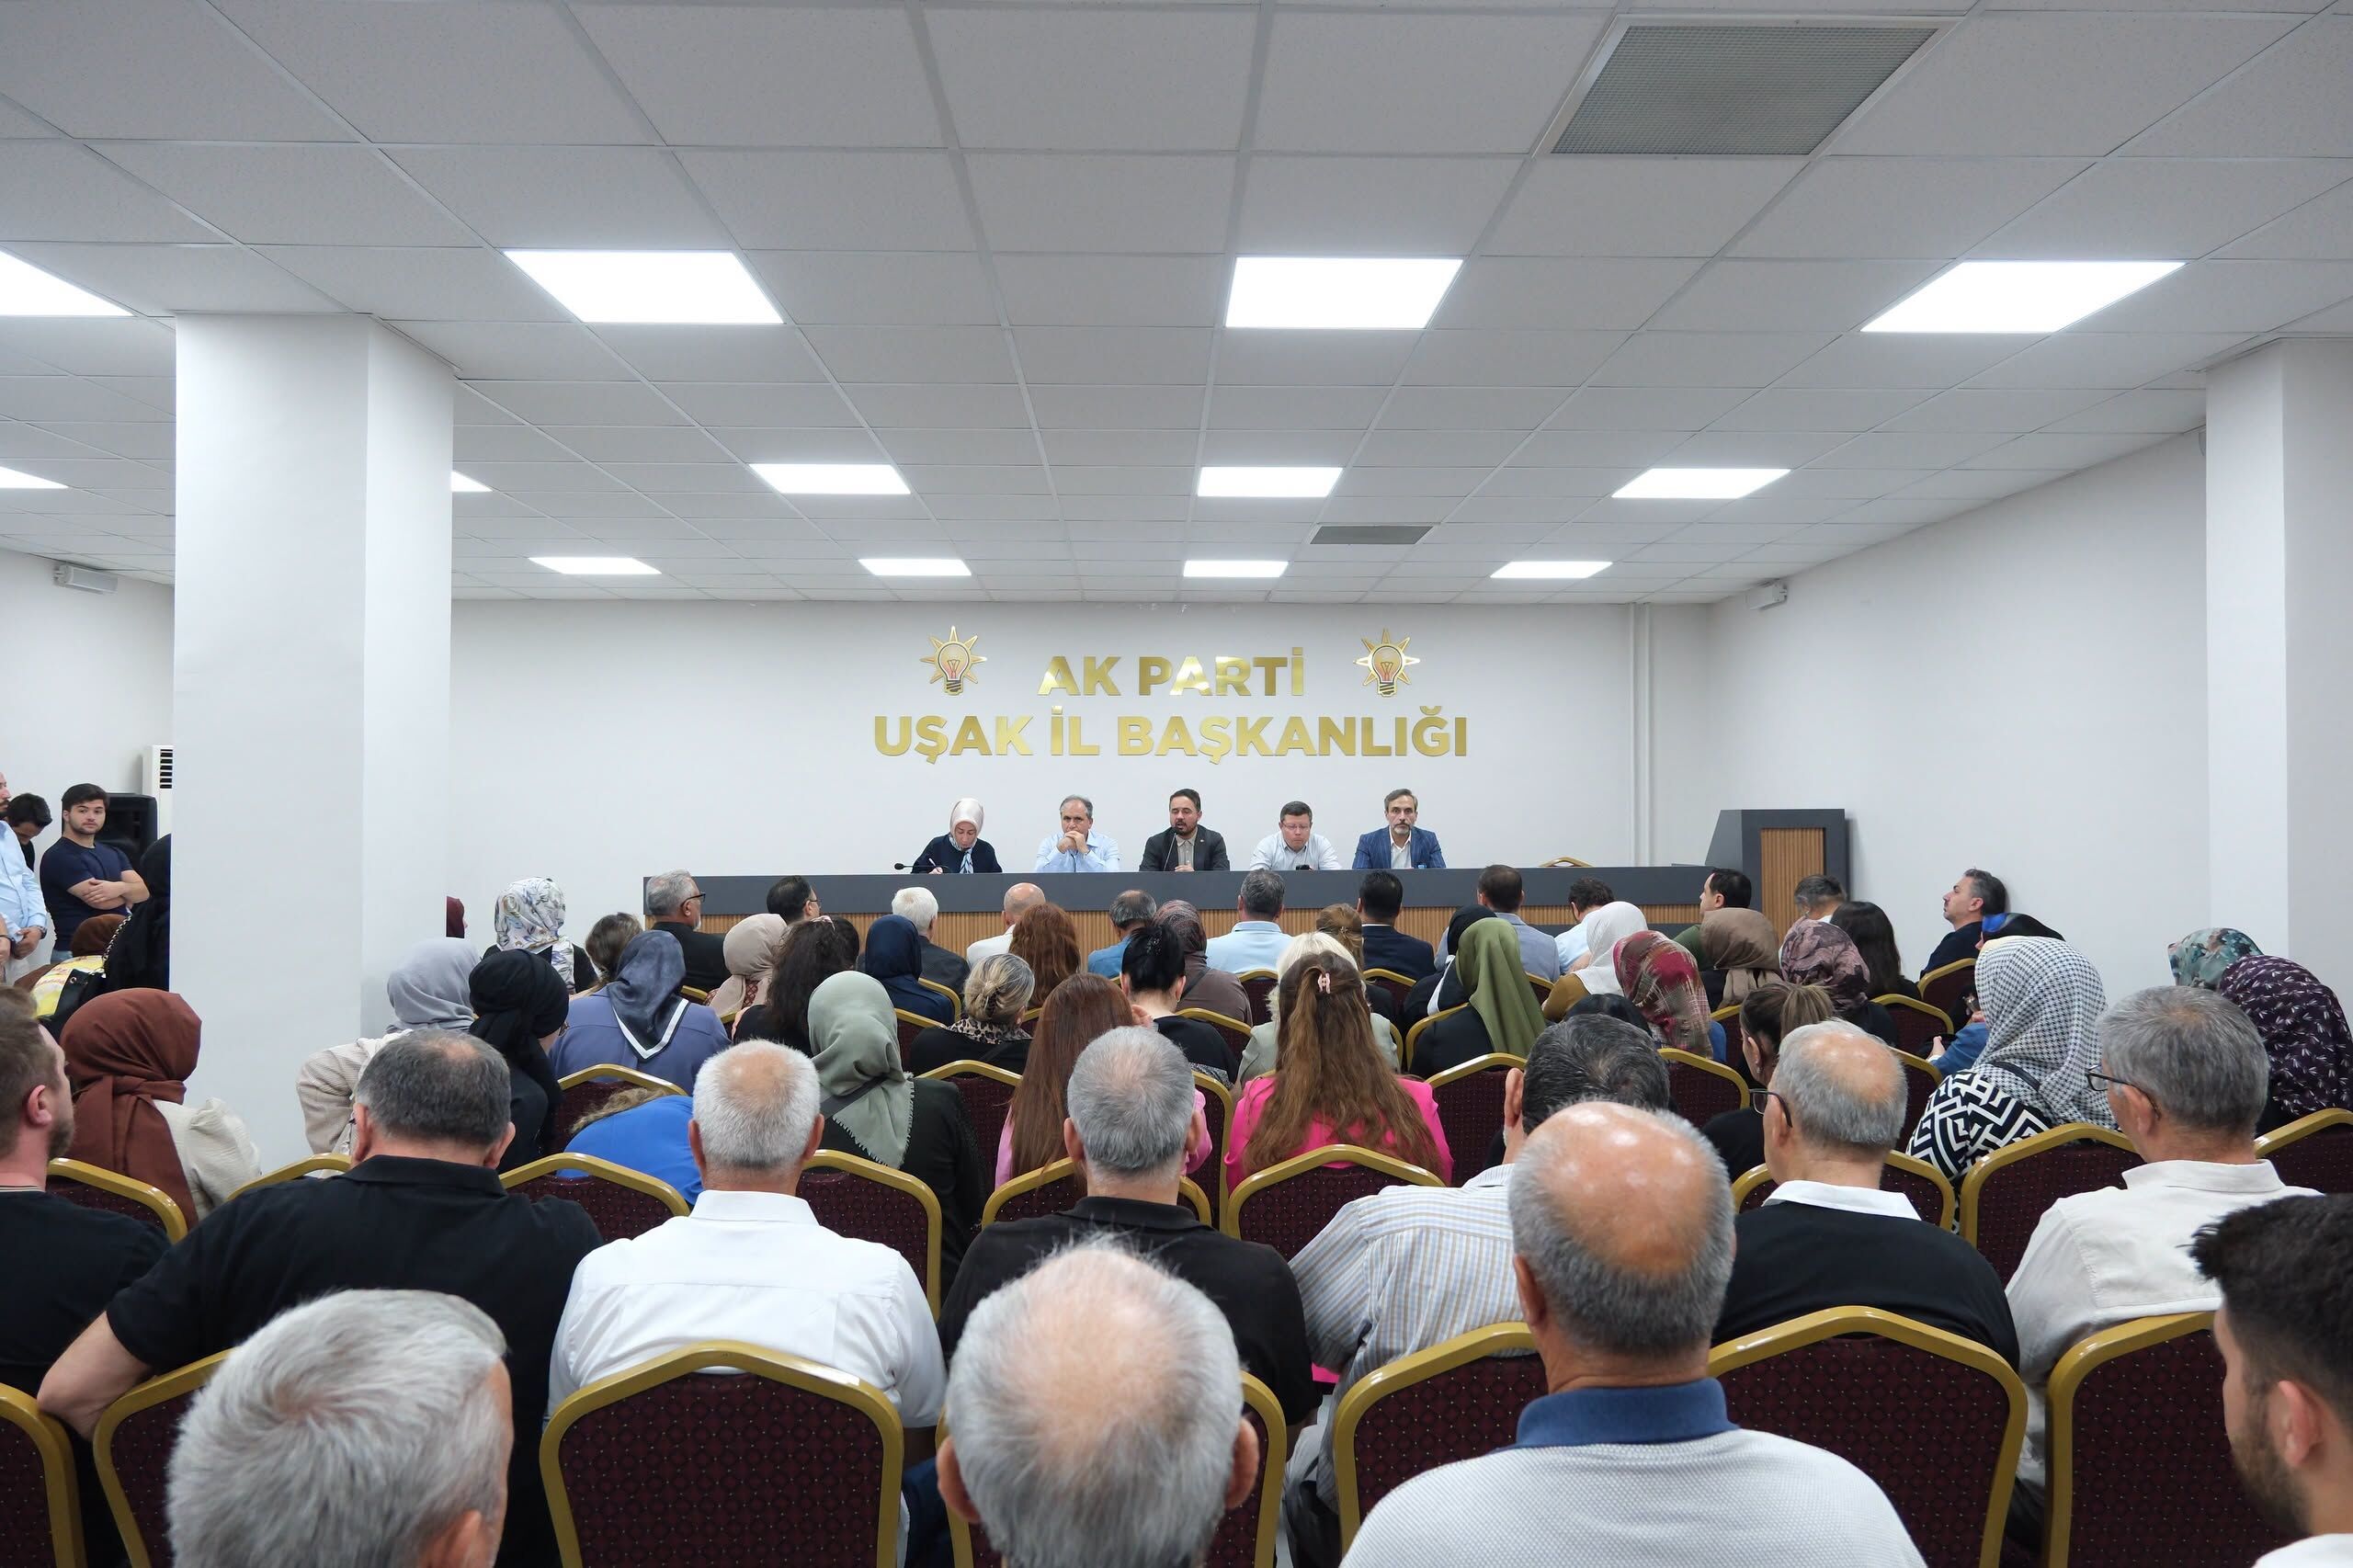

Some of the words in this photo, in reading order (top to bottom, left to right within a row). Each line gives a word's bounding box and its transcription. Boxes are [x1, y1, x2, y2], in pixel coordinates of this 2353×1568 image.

[1037, 656, 1122, 696] AK
[1139, 647, 1303, 696] PARTİ
[874, 715, 1033, 764] UŞAK
[1051, 705, 1100, 756] İL
[1118, 706, 1467, 765] BAŞKANLIĞI
